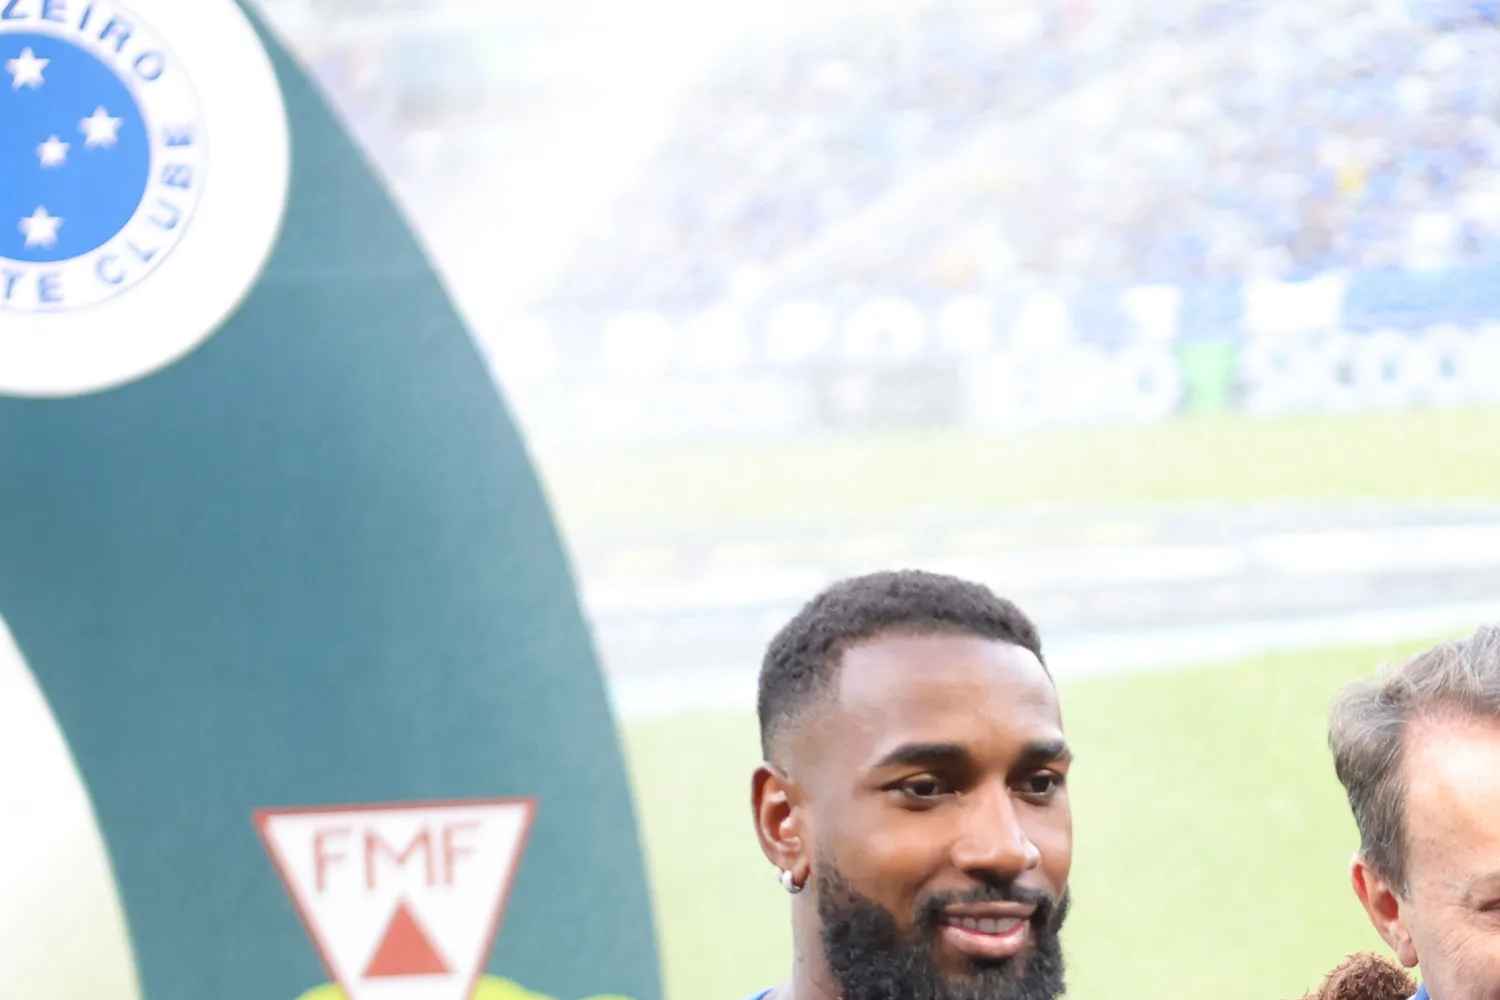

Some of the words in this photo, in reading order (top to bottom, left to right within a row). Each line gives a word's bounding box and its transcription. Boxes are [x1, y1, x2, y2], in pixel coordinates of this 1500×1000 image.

[1, 0, 166, 81] ZEIRO
[95, 124, 194, 286] CLUBE
[312, 819, 483, 894] FMF
